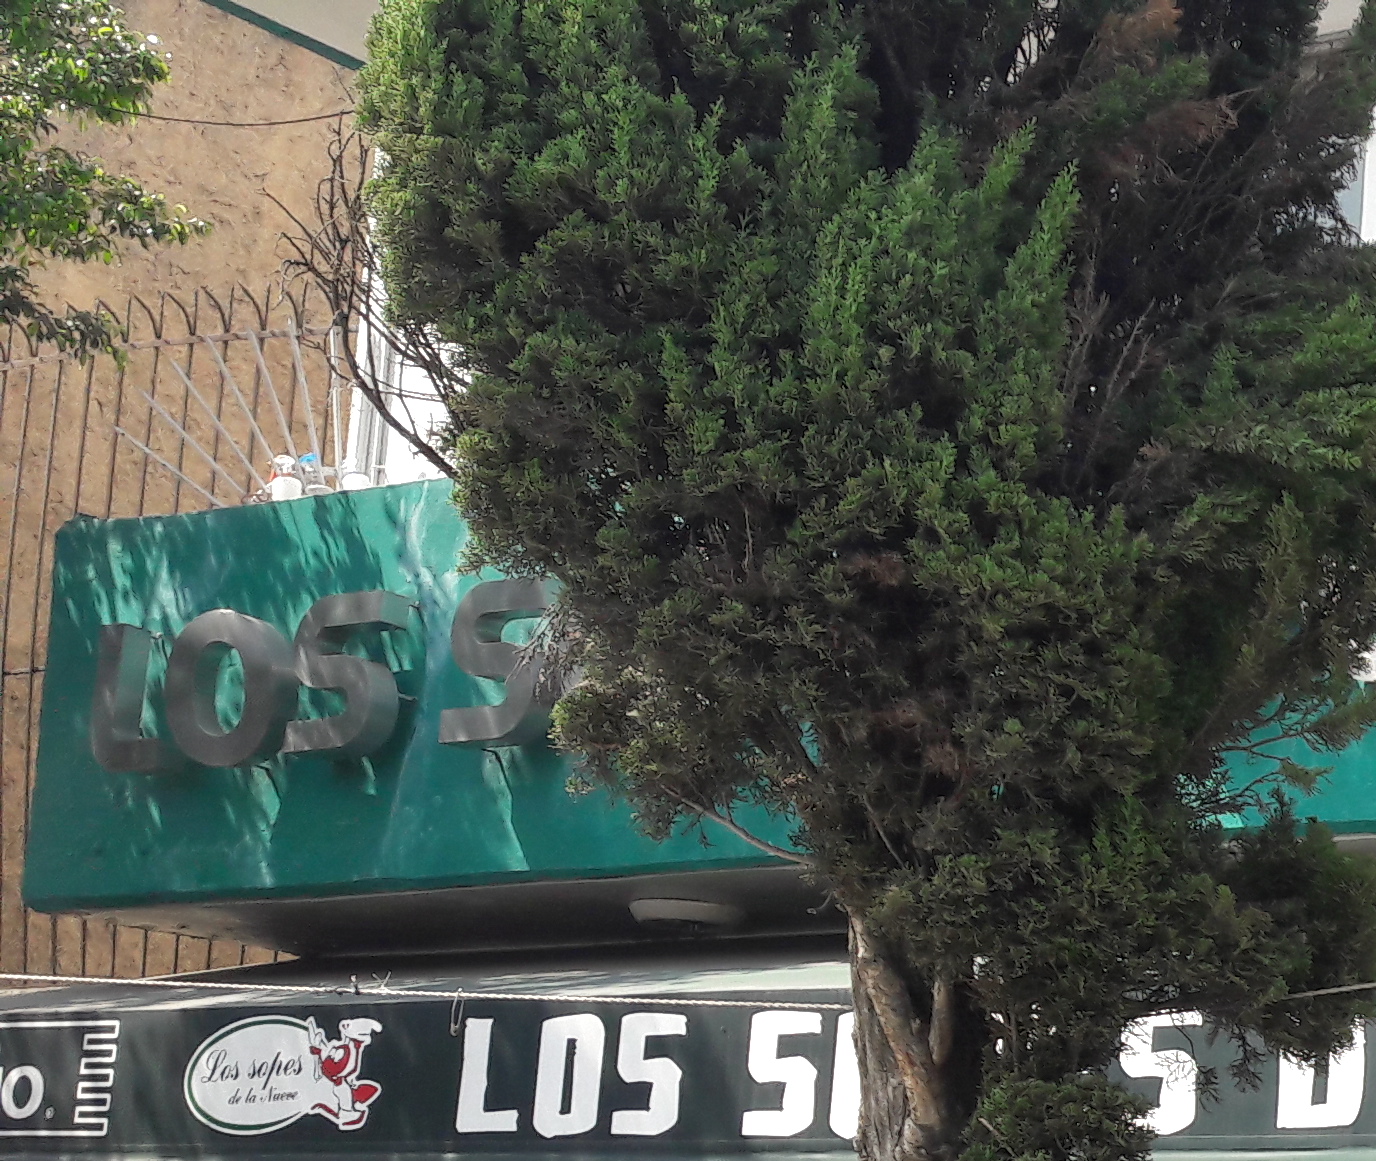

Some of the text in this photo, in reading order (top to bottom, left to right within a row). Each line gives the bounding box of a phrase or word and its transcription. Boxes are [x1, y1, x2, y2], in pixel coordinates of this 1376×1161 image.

[91, 590, 412, 774] LOS
[201, 1049, 302, 1090] Los sopes
[228, 1088, 241, 1104] de
[245, 1087, 256, 1103] la
[456, 1012, 690, 1138] LOS
